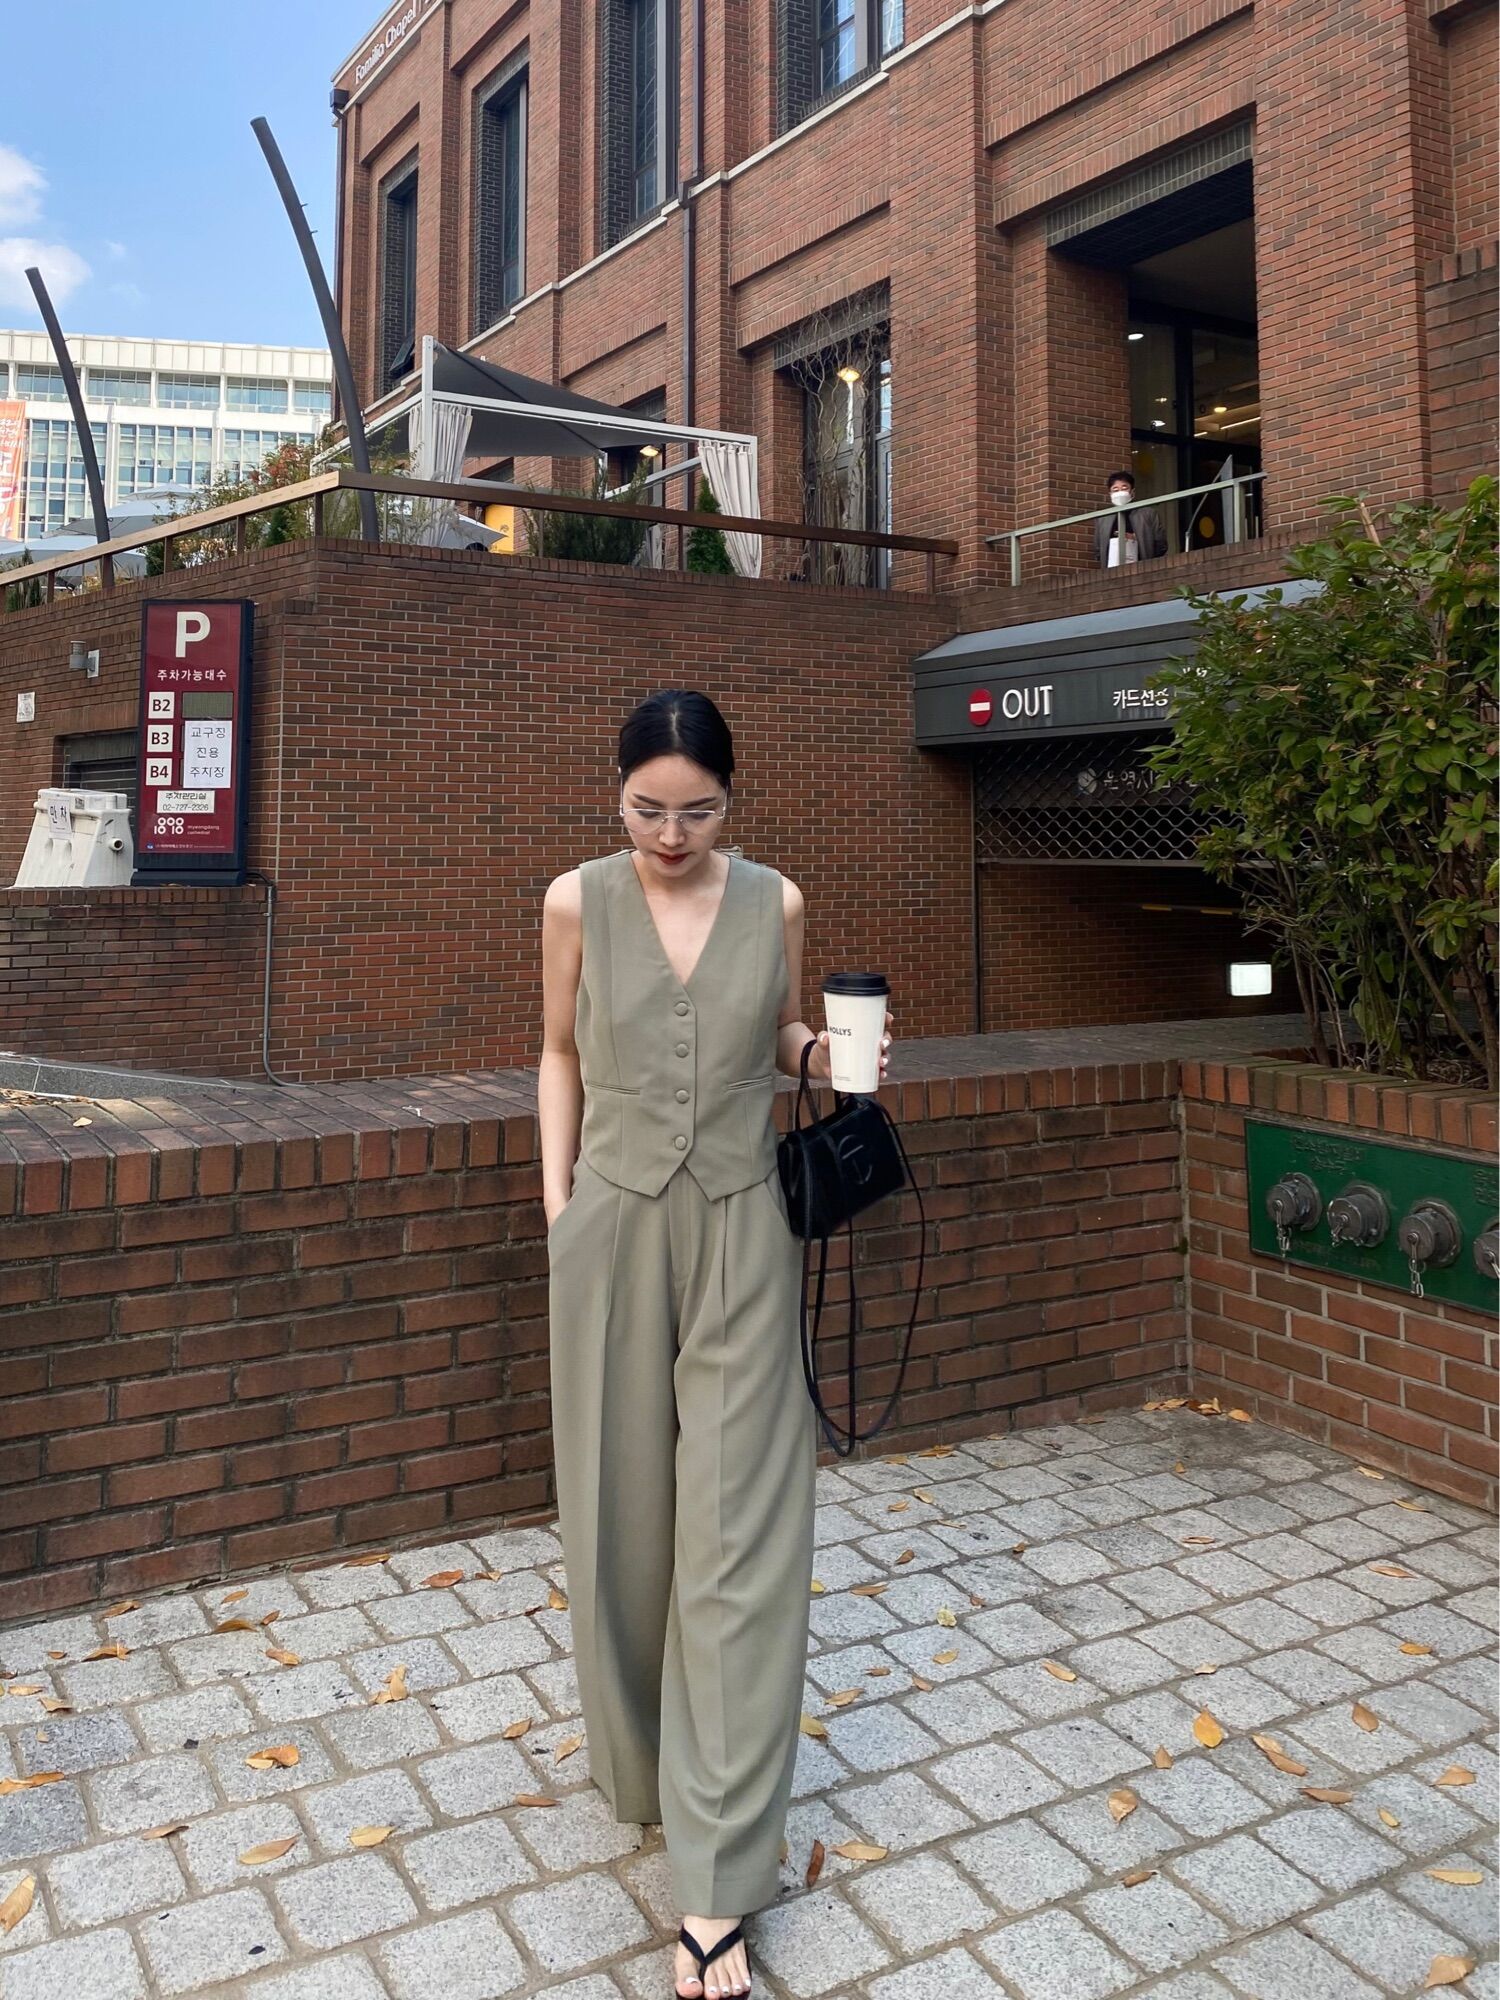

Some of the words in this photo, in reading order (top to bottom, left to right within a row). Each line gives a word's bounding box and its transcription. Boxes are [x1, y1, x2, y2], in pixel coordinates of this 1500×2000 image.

[355, 43, 385, 85] Familia
[385, 0, 417, 49] Chapel
[175, 611, 211, 658] P
[157, 669, 227, 682] 주차가능대수
[152, 699, 171, 712] B2
[1002, 685, 1053, 719] OUT
[151, 732, 170, 745] B3
[150, 765, 168, 778] B4
